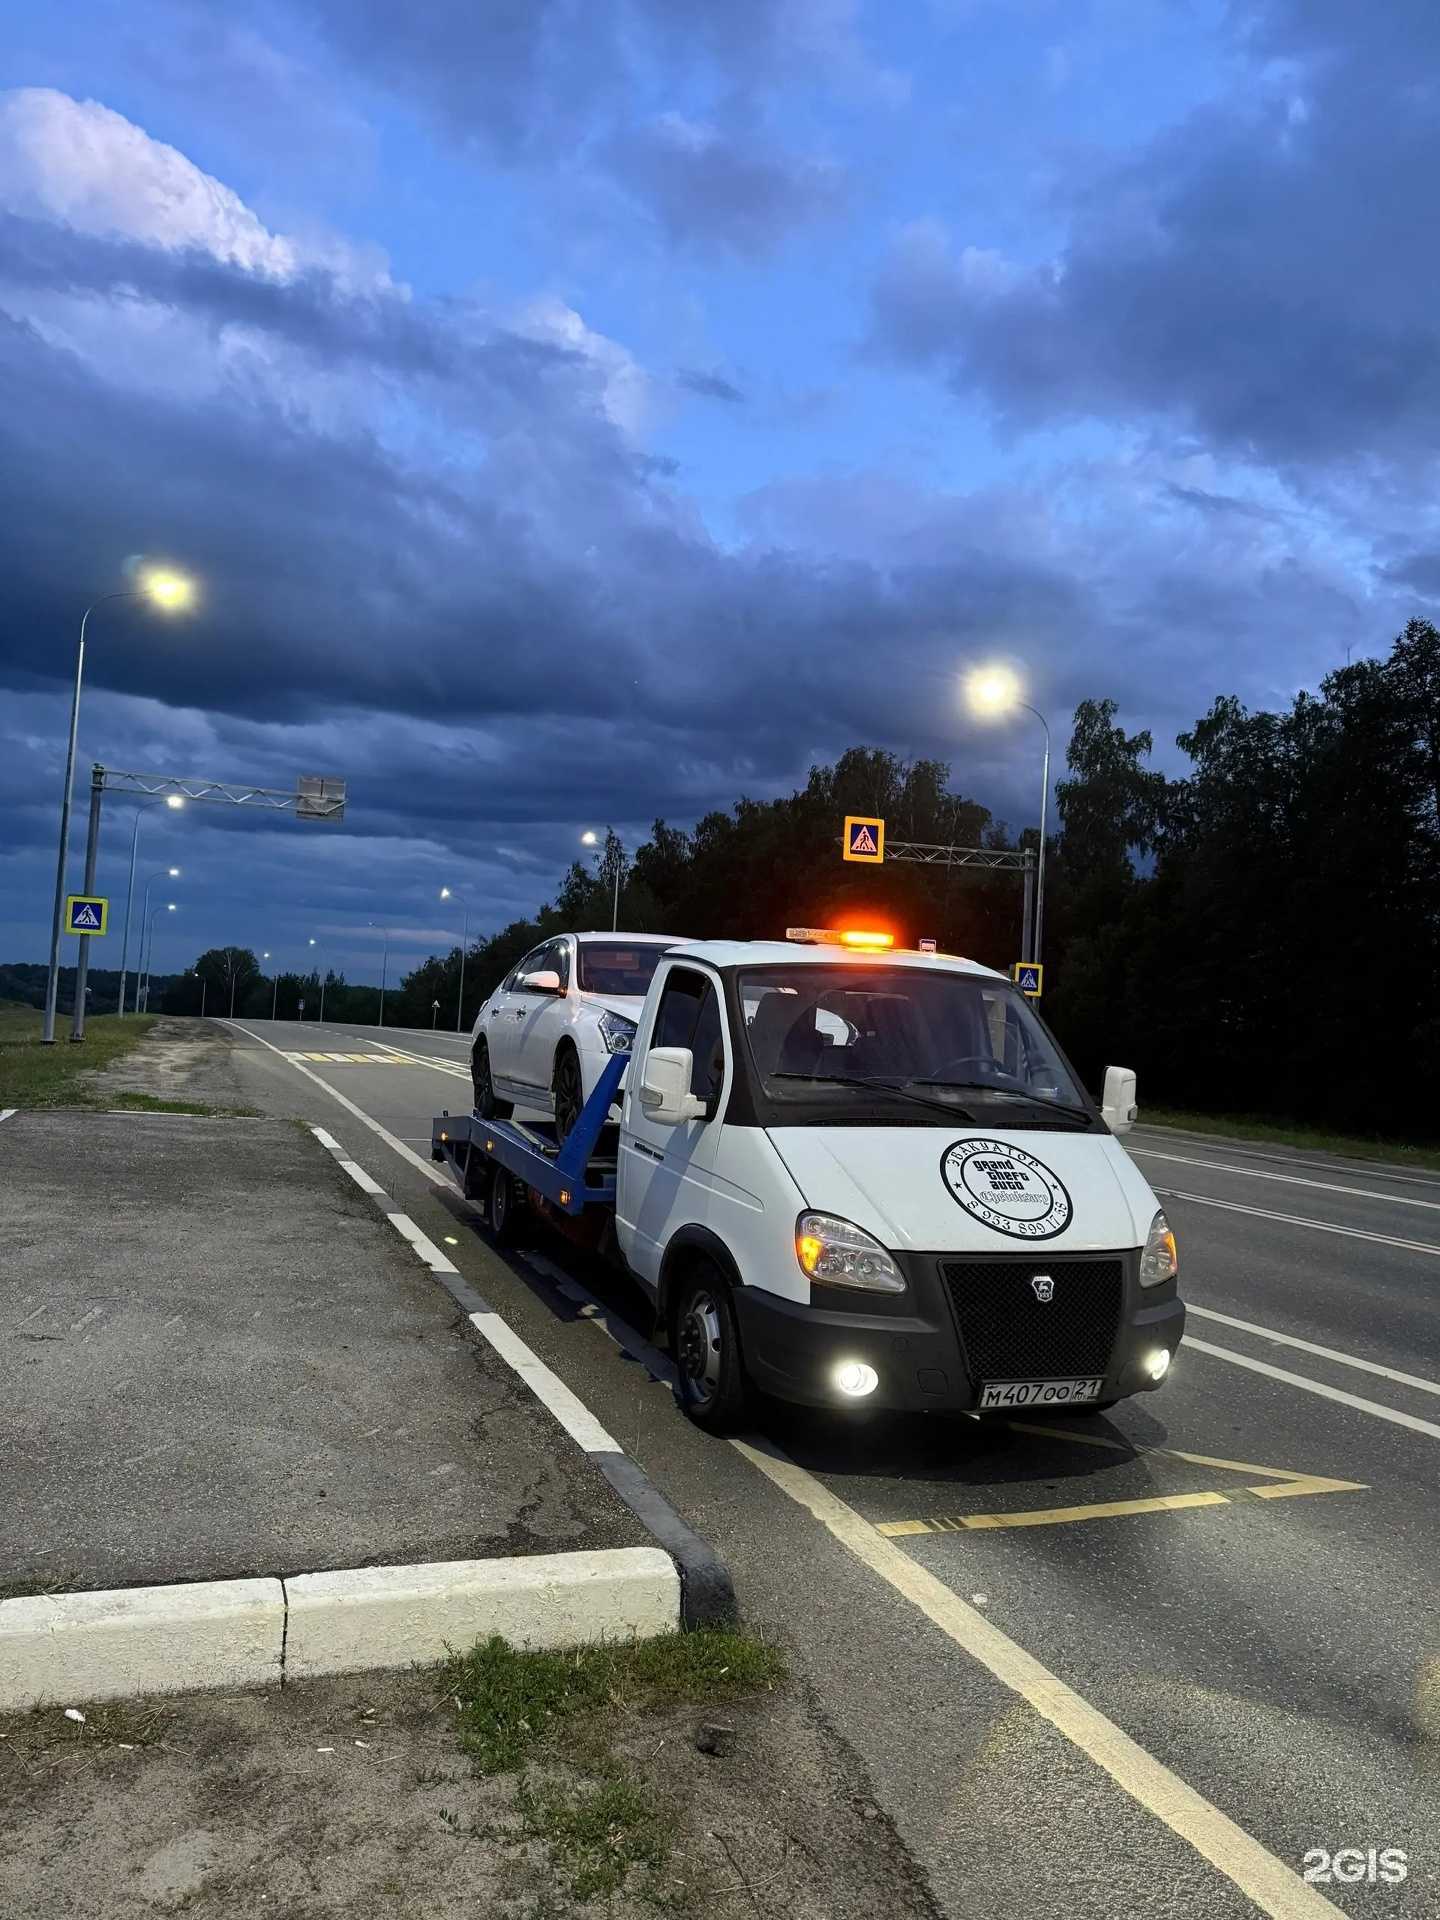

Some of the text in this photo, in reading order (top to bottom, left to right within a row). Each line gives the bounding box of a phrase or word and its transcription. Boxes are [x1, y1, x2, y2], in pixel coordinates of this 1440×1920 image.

[946, 1142, 1039, 1168] ЭВАКУАТОР
[966, 1200, 979, 1209] 8
[981, 1210, 1011, 1230] 953
[1018, 1222, 1046, 1235] 899
[1045, 1214, 1061, 1229] 17
[1075, 1380, 1098, 1395] 21
